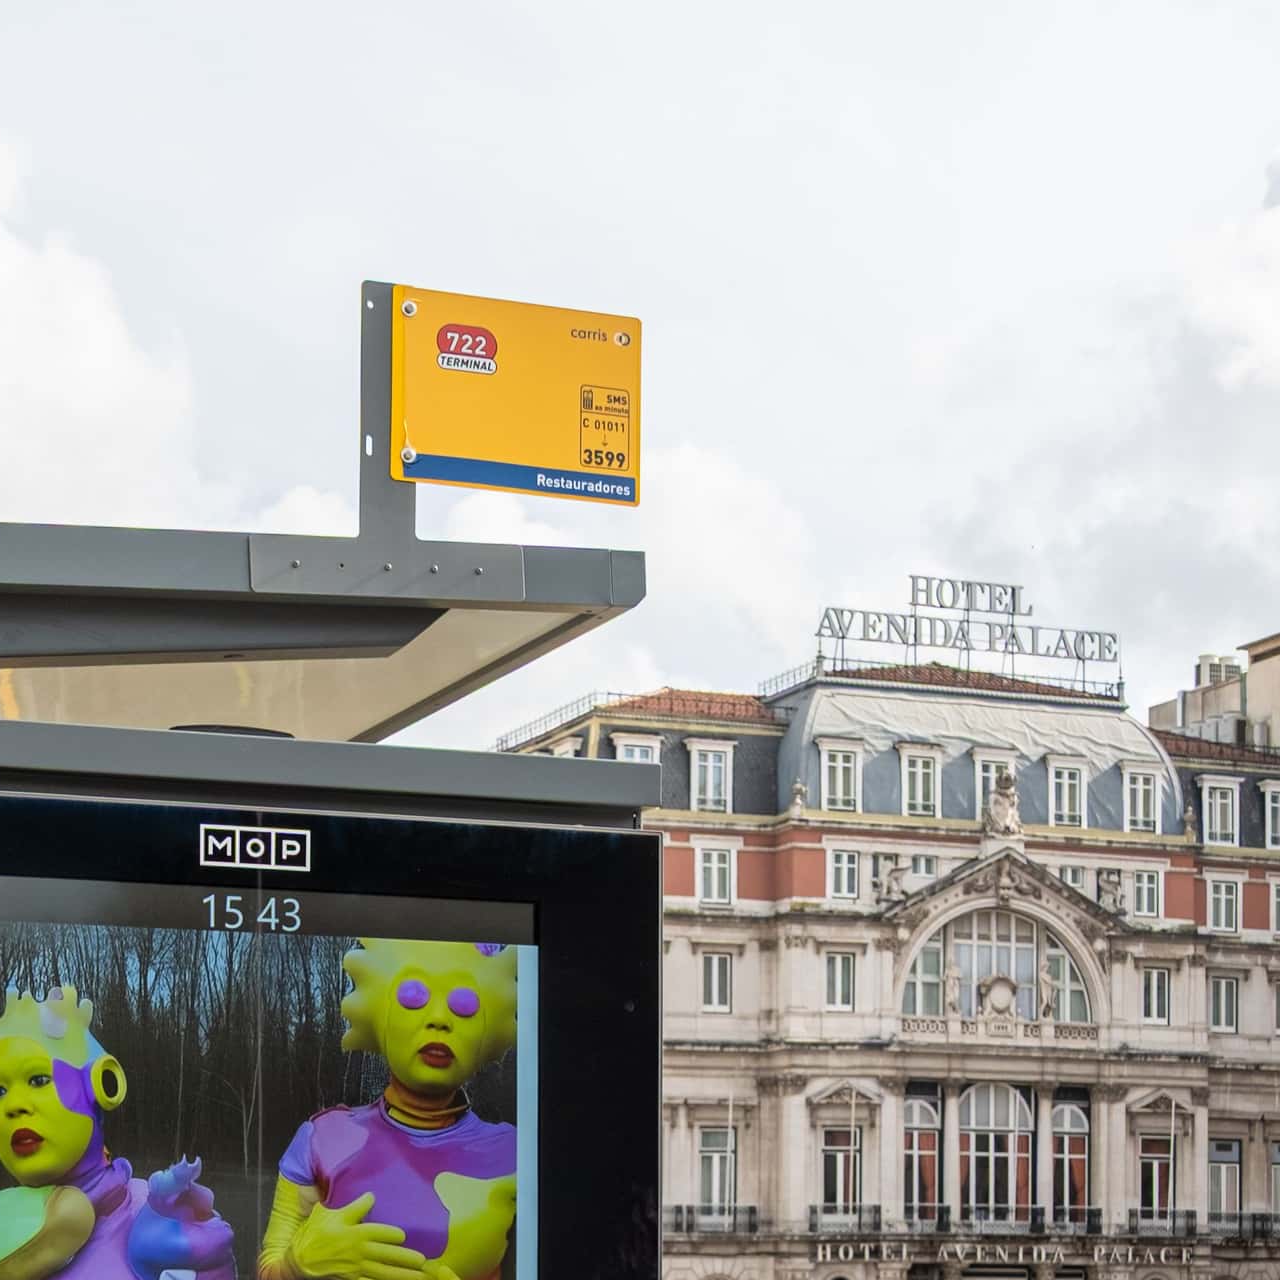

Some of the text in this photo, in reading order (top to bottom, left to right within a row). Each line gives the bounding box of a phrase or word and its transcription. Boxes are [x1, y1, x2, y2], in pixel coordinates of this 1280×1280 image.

[446, 331, 487, 356] 722
[570, 328, 608, 342] carris
[440, 356, 495, 373] TERMINAL
[607, 394, 628, 406] SMS
[582, 418, 625, 433] C 01011
[583, 448, 626, 468] 3599
[536, 473, 631, 496] Restauradores
[908, 574, 1033, 616] HOTEL
[814, 606, 1118, 663] AVENIDA PALACE
[207, 835, 301, 860] MOP
[816, 1243, 1193, 1265] HOTEL AVENIDA PALACE
